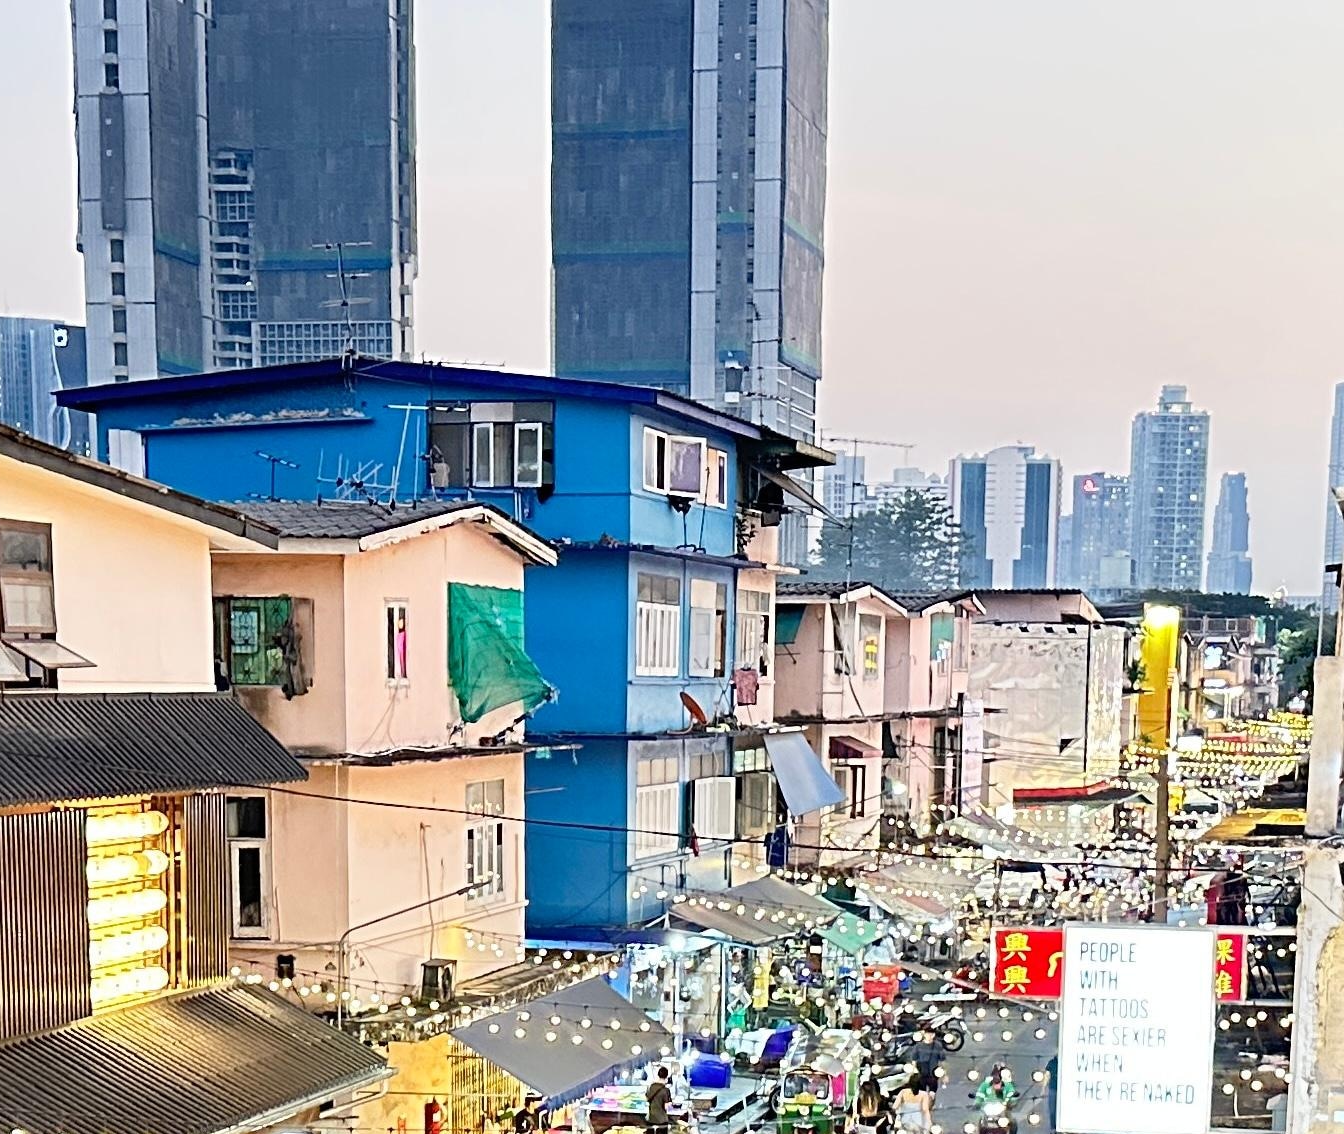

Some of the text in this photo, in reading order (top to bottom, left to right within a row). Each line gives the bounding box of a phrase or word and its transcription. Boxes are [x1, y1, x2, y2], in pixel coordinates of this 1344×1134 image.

[1079, 942, 1137, 963] PEOPLE
[1079, 970, 1118, 990] WITH
[1079, 998, 1149, 1019] TATTOOS
[1076, 1026, 1168, 1047] ARE SEXIER
[1076, 1053, 1124, 1073] WHEN
[1143, 1081, 1196, 1105] NAKED
